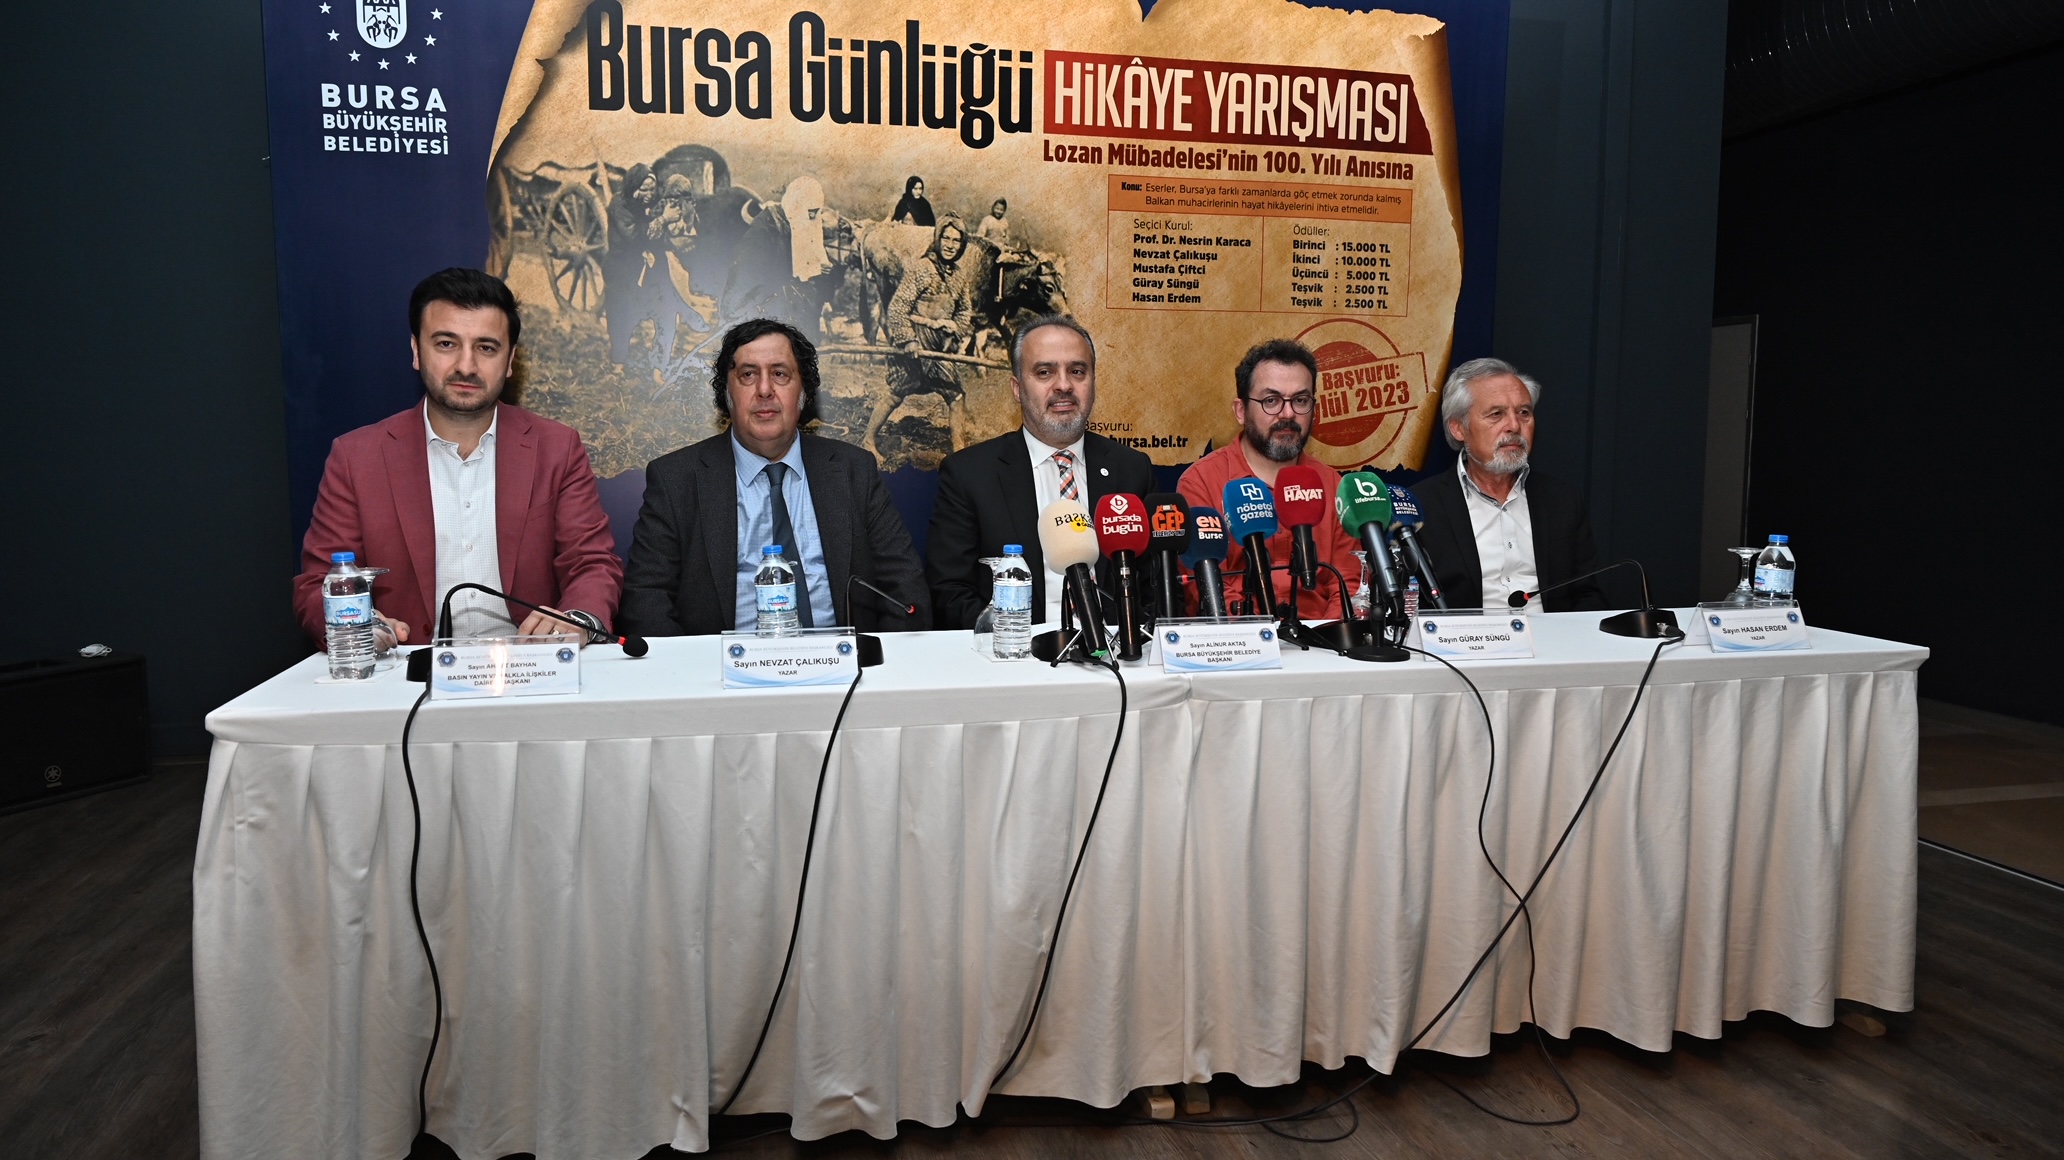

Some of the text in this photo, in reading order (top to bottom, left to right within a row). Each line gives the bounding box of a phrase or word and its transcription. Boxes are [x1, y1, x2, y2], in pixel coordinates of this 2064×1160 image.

[586, 0, 1033, 149] Bursa Günlüğü
[321, 83, 447, 112] BURSA
[1204, 69, 1409, 144] YARIŞMASI
[322, 110, 448, 134] BÜYÜKŞEHİR
[323, 133, 449, 155] BELEDİYESİ
[1043, 139, 1414, 181] Lozan Mübadelesi'nin 100. Yılı Anısına
[1121, 182, 1143, 191] Konu:
[1179, 184, 1216, 196] Bursa'ya
[1218, 185, 1239, 196] farklı
[1242, 187, 1291, 198] zamanlarda
[1293, 190, 1309, 200] göç
[1311, 190, 1338, 200] etmek
[1340, 192, 1374, 202] zorunda
[1376, 194, 1402, 205] kalmış
[1145, 196, 1379, 215] Balkan muhacirlerinin hayat hikâyelerini ihtiva etmelidir.
[1133, 218, 1193, 231] Seçici Kurul:
[1293, 223, 1330, 236] Ödüller:
[1133, 234, 1251, 247] Prof. Dr. Nesrin Karaca
[1292, 239, 1326, 250] Birinci
[1341, 242, 1376, 252] 15.000
[1379, 243, 1391, 253] TL
[1133, 248, 1218, 262] Nevzat Çalıkuşu
[1292, 251, 1321, 265] İkinci
[1341, 256, 1377, 267] 10.000
[1379, 258, 1391, 267] TL
[1132, 263, 1206, 276] Mustafa Çiftci
[1291, 266, 1329, 280] Üçüncü
[1346, 270, 1376, 281] 5.000
[1378, 272, 1391, 282] TL
[1132, 277, 1200, 290] Güray Süngü
[1291, 282, 1324, 294] Teşvik
[1345, 284, 1375, 295] 2.500
[1377, 286, 1389, 296] TL
[1132, 292, 1202, 304] Hasan Erdem
[1290, 296, 1323, 309] Teşvik
[1344, 298, 1374, 309] 2.500
[1376, 300, 1388, 310] TL
[1322, 362, 1401, 391] Başvuru:
[1355, 380, 1411, 413] 2023
[1284, 488, 1323, 502] HAYAT
[1236, 502, 1273, 514] nöbetçi
[1102, 514, 1142, 525] bursada
[1152, 511, 1185, 531] CEP
[1240, 510, 1273, 523] gazete
[1102, 522, 1143, 535] bugün
[1438, 633, 1511, 644] Sayın GÜRAY SÜNGÜ
[1234, 648, 1262, 656] BELEDİYE
[734, 657, 840, 668] Sayın NEVZAT ÇALIKUŞU
[526, 670, 557, 678] İLİŞKİLER
